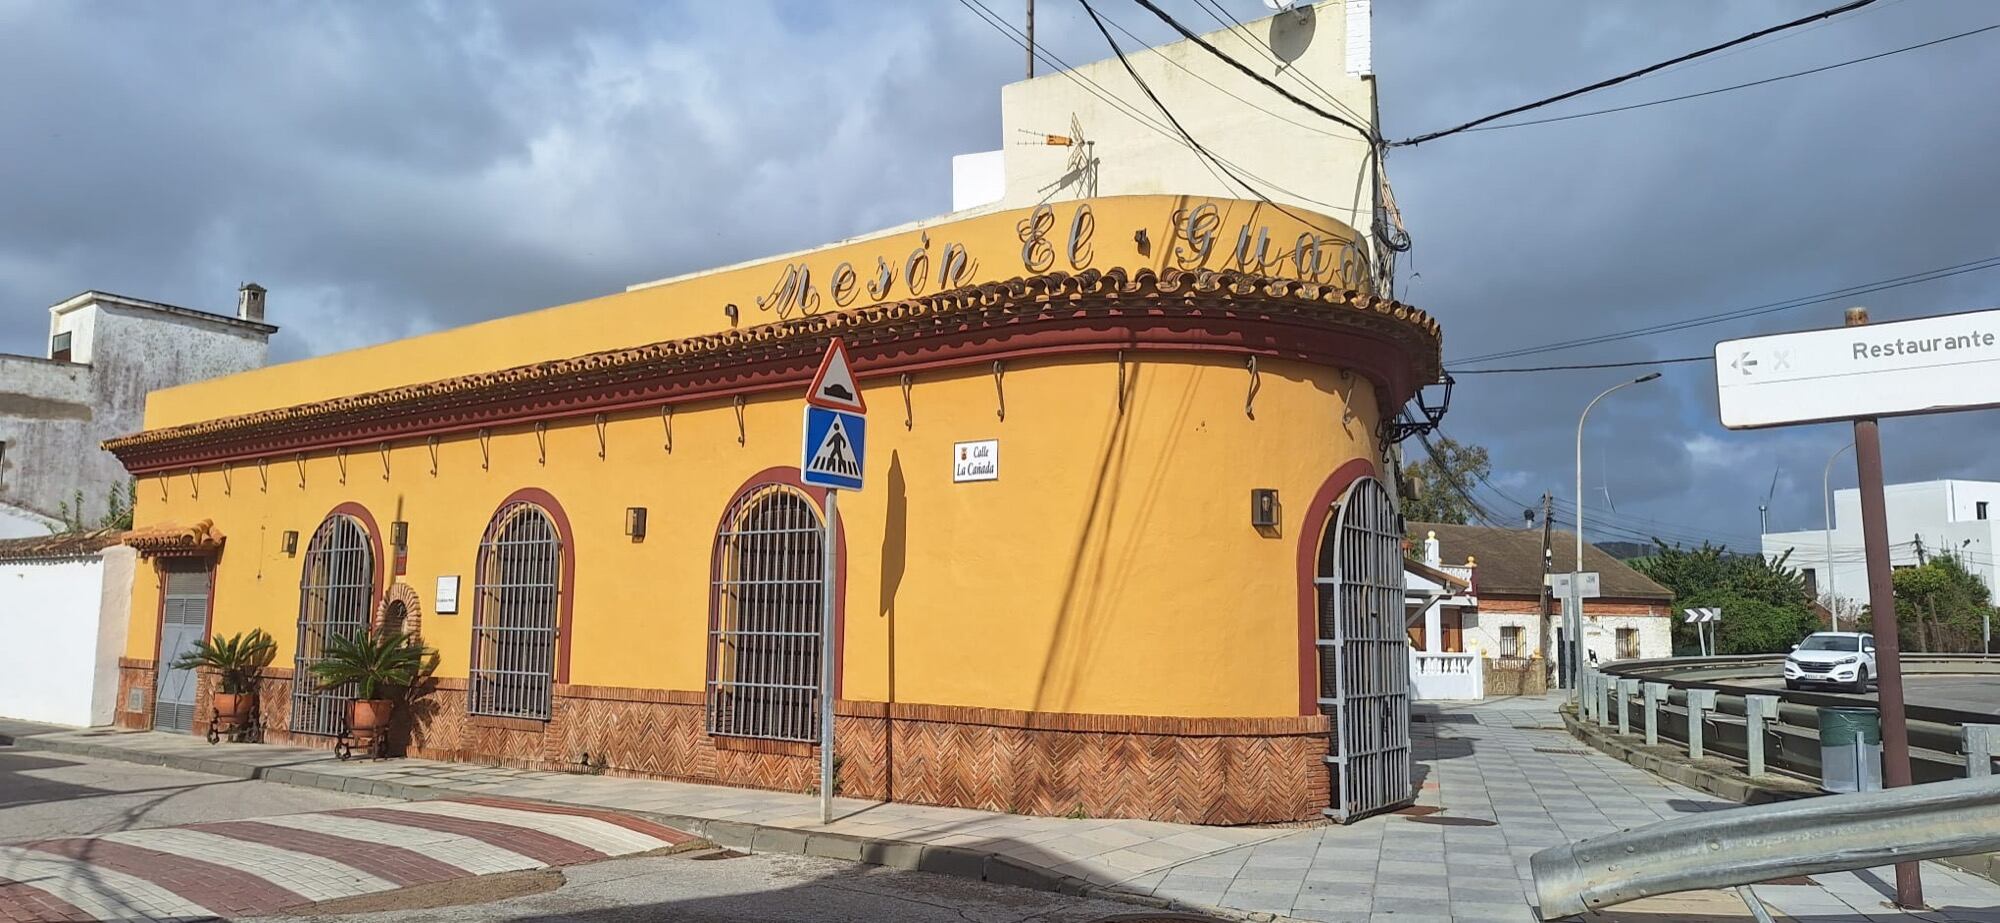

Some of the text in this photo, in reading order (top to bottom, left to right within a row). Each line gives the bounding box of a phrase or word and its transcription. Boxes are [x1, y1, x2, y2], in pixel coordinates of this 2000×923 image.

[756, 231, 977, 317] Mesón
[1016, 203, 1092, 268] El
[1852, 330, 1995, 360] Restaurante
[973, 445, 989, 458] Calle
[957, 461, 994, 476] La Cañada
